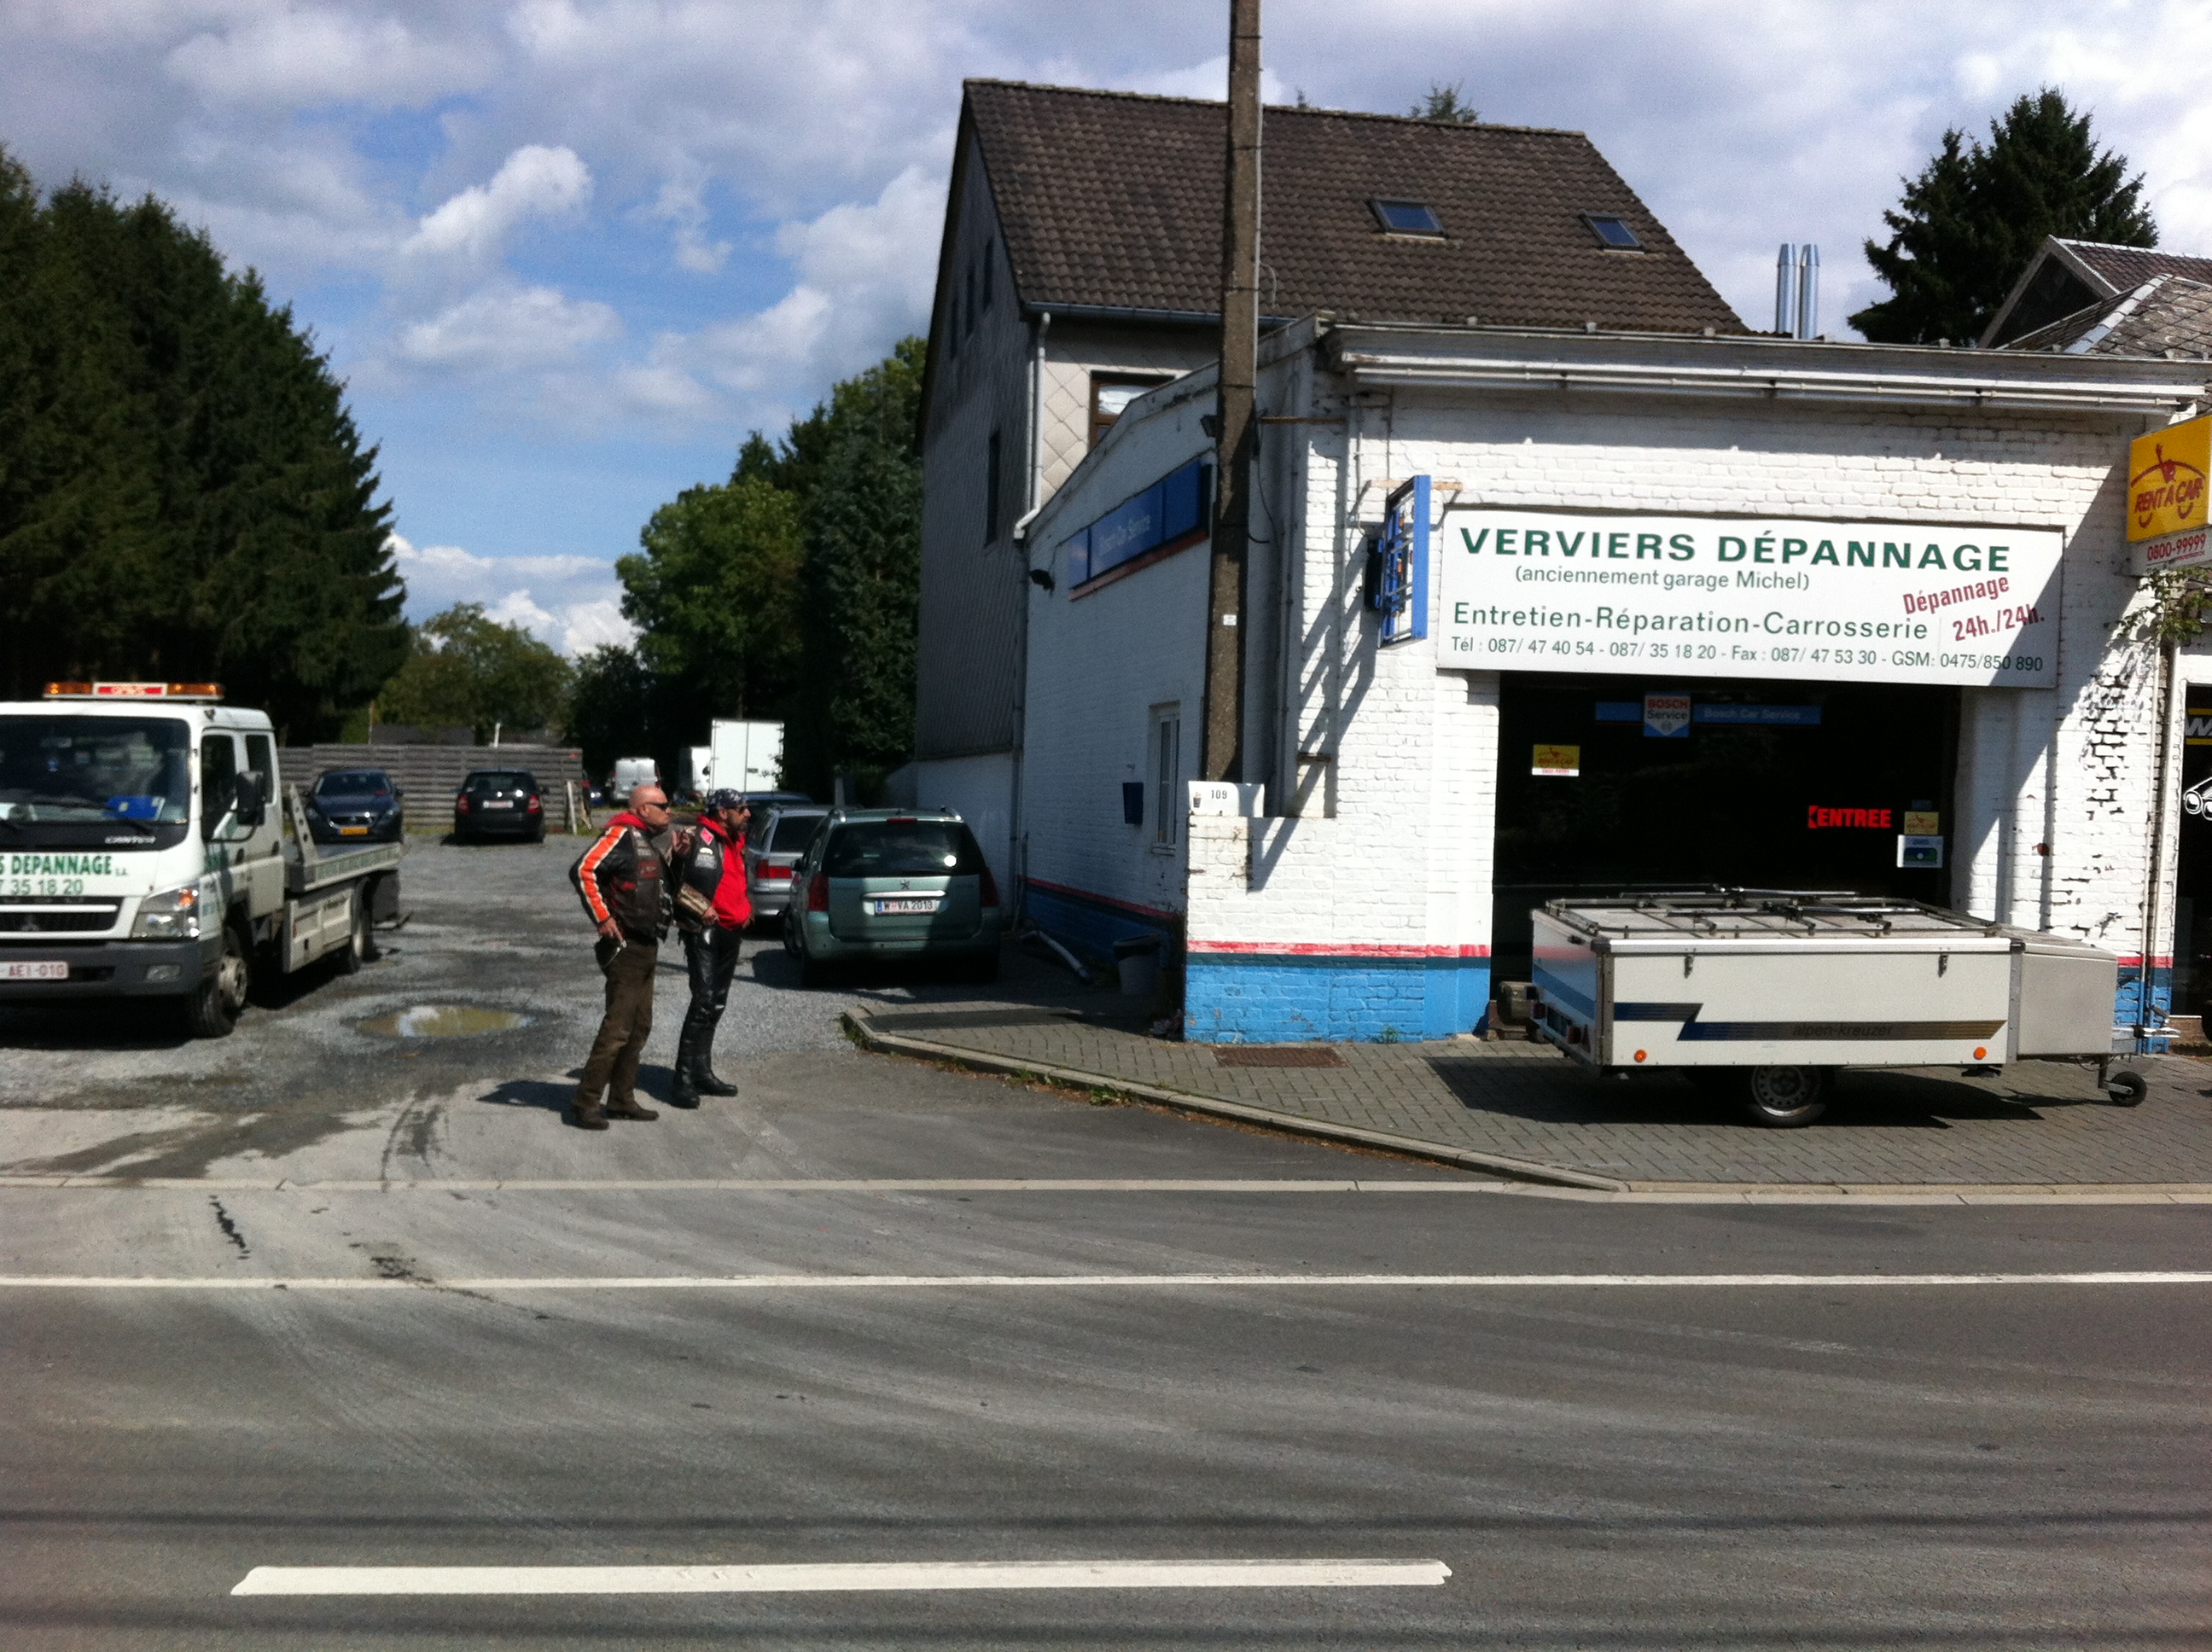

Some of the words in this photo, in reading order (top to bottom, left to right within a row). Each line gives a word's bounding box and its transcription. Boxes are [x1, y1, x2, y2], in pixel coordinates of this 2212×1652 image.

[1460, 527, 1695, 561] VERVIERS
[1718, 530, 2010, 573] DÉPANNAGE
[2146, 533, 2207, 561] 0800-99999
[1516, 566, 1659, 585] (anciennement
[1663, 572, 1729, 591] garage
[1736, 570, 1809, 591] Michel)
[1903, 576, 2010, 614] Dépannage
[1453, 602, 1929, 640] Entretien-Réparation-Carrosserie
[1953, 604, 2046, 642] 24h./24h.
[1528, 639, 1547, 654] 47
[1551, 640, 1571, 654] 40
[1575, 641, 1594, 655] 54
[1650, 643, 1669, 658] 35
[1675, 644, 1693, 659] 18
[1697, 645, 1716, 660] 20
[1732, 645, 1758, 660] Fax
[1811, 649, 1830, 663] 47
[1834, 649, 1854, 664] 53
[1857, 650, 1877, 665] 30
[1891, 651, 1936, 667] GSM:
[1940, 654, 2011, 670] 0475/850
[2015, 655, 2044, 672] 890
[1647, 697, 1689, 709] BOSCH
[1646, 709, 1688, 720] Service
[1211, 789, 1228, 800] 109
[1817, 808, 1892, 829] ENTREE
[11, 855, 112, 875] DEPANNAGE
[10, 879, 31, 896] 35
[38, 879, 57, 896] 18
[62, 879, 84, 896] 20
[911, 900, 933, 910] 2013
[1792, 1023, 1894, 1038] alpen-kreuzer
